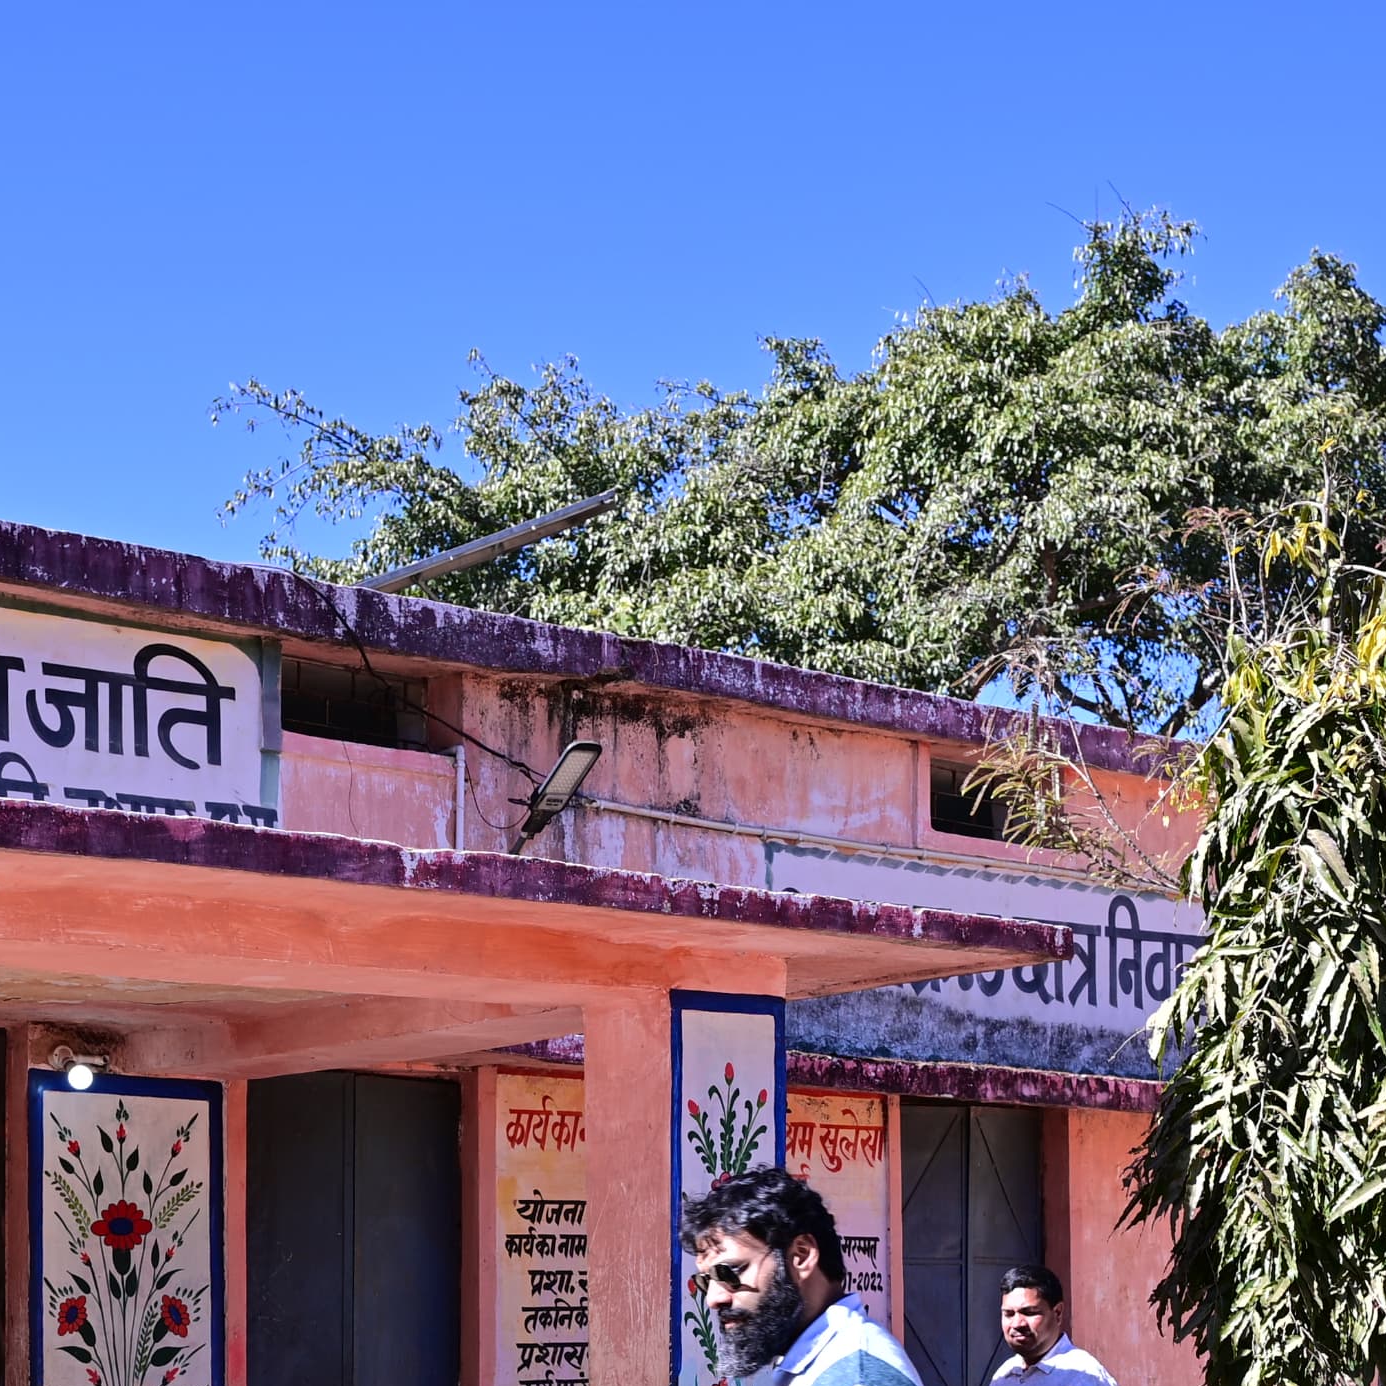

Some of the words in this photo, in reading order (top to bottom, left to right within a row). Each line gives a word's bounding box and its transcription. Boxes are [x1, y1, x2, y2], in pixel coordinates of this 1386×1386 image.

[25, 643, 236, 770] जाति
[1105, 894, 1210, 1010] निवा
[506, 1095, 553, 1152] कार्य
[516, 1189, 587, 1226] योजना
[516, 1343, 589, 1373] प्रशास
